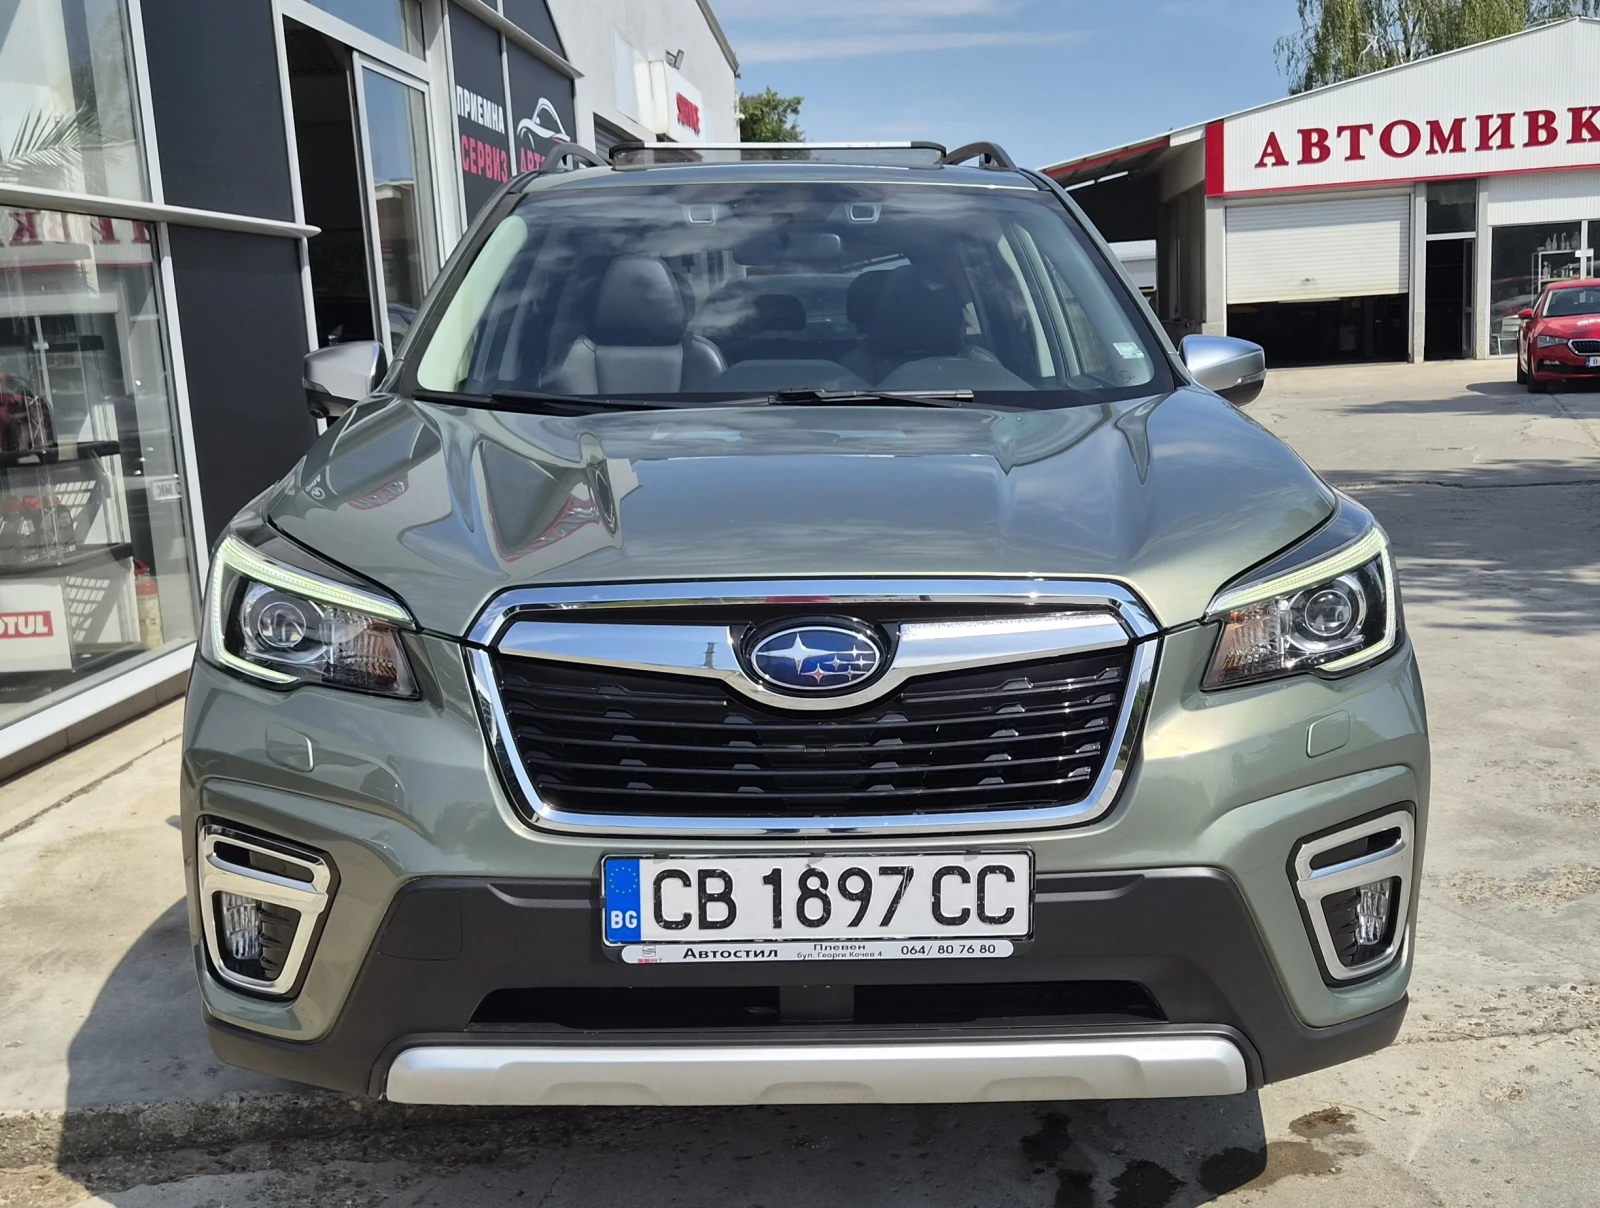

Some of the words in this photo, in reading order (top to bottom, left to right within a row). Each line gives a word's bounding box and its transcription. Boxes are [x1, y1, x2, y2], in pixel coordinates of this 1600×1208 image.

[456, 84, 505, 135] ПРИЕМНА
[1255, 105, 1600, 169] АВТОМИВК
[461, 134, 509, 184] СЕРВИЗ
[520, 147, 546, 174] АВТ
[653, 868, 737, 930] CB
[762, 866, 914, 929] 1897
[931, 864, 1015, 927] CC
[610, 910, 638, 929] BG
[682, 948, 778, 959] Автостил
[797, 951, 814, 960] бул.
[817, 951, 847, 959] Георги
[813, 943, 866, 951] Плевен
[901, 945, 932, 956] 064/
[937, 944, 954, 955] 80
[959, 944, 975, 954] 76
[979, 944, 996, 954] 80
